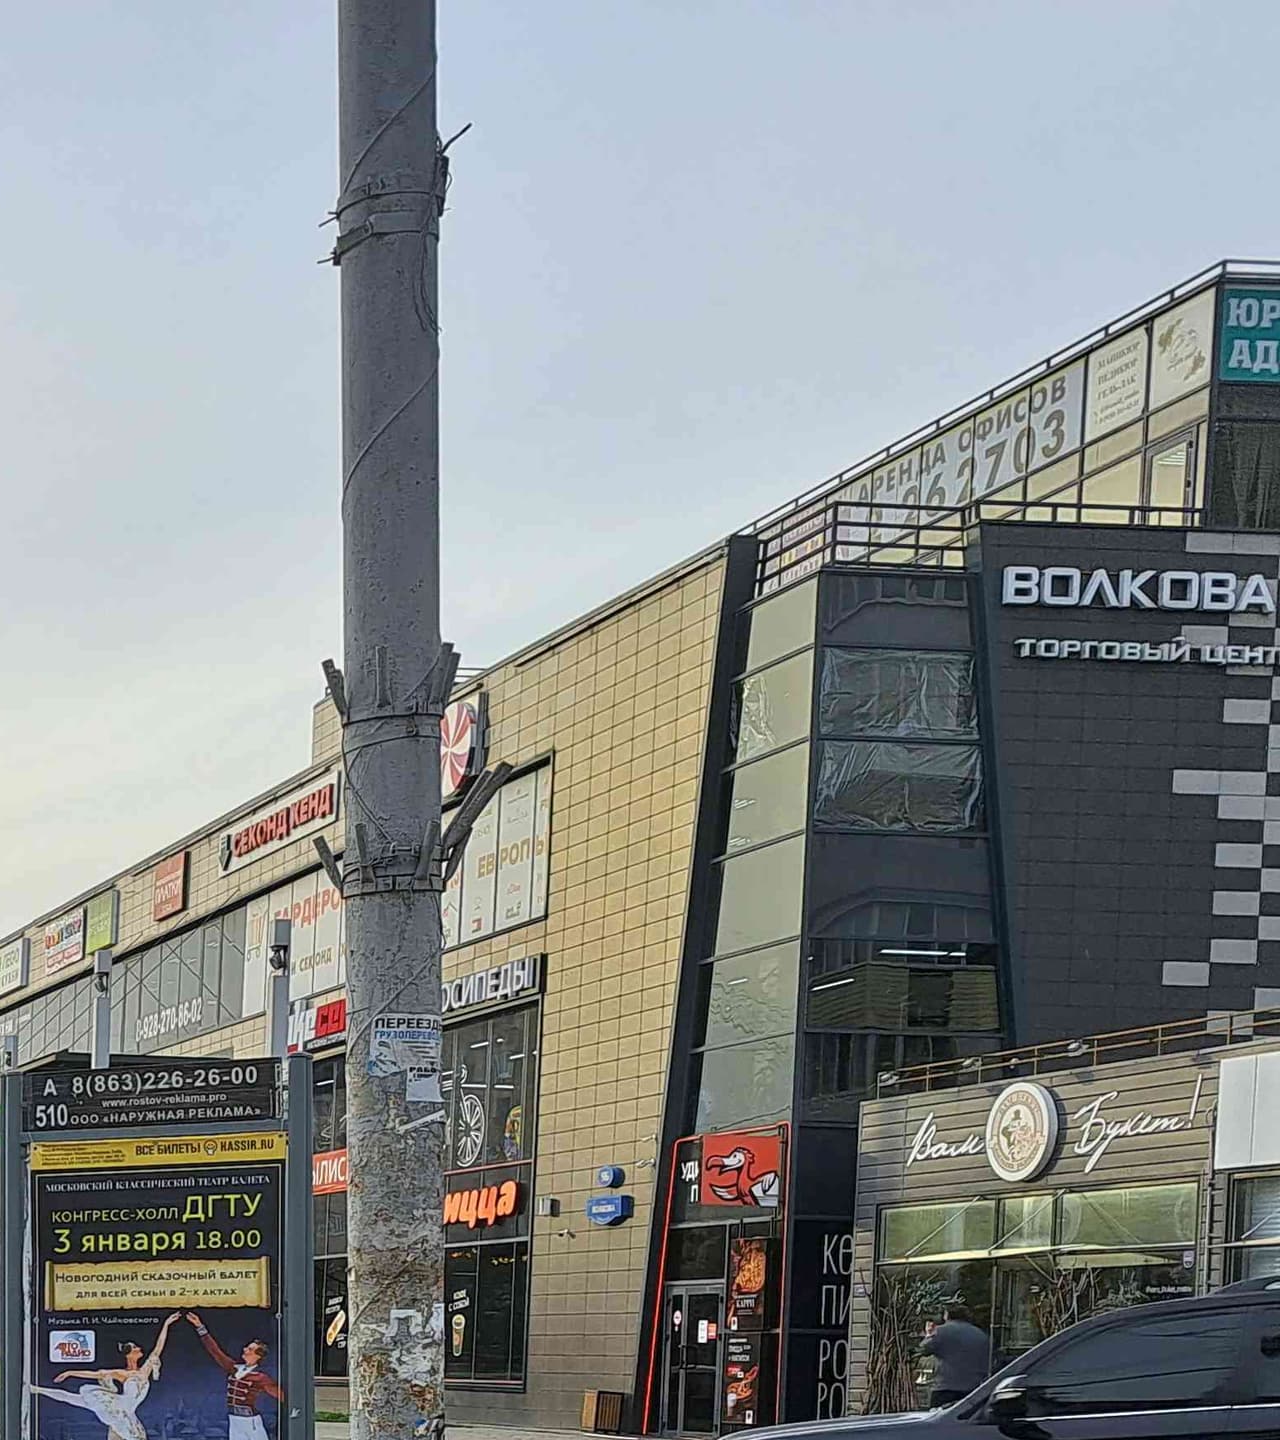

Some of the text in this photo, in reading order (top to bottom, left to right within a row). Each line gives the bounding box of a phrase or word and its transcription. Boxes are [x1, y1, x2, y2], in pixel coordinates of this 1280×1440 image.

[958, 375, 1067, 453] ОФИСОВ
[1001, 565, 1277, 613] ВОЛКОВА
[1013, 634, 1192, 663] ТОРГОВЫЙ
[234, 783, 335, 858] СЕКОНД ХЕНД
[72, 1065, 259, 1098] 8(863)226-26-00
[101, 1092, 228, 1109] www.rostov-reklama.pro
[35, 1103, 69, 1129] 510
[102, 1108, 185, 1125] «НАРУЖНАЯ
[188, 1105, 262, 1120] РЕКЛАМА»
[134, 1144, 156, 1157] ВСЕ
[156, 1142, 202, 1156] БИЛЕТЫ
[44, 1174, 272, 1193] МОСКОВСКИЙ КЛАССИЧЕСКИЙ ТЕАТР БАЛЕТА
[51, 1192, 263, 1224] КОНГРЕСС-ХОЛЛ ДГТУ
[53, 1228, 262, 1256] 3 января 18.00
